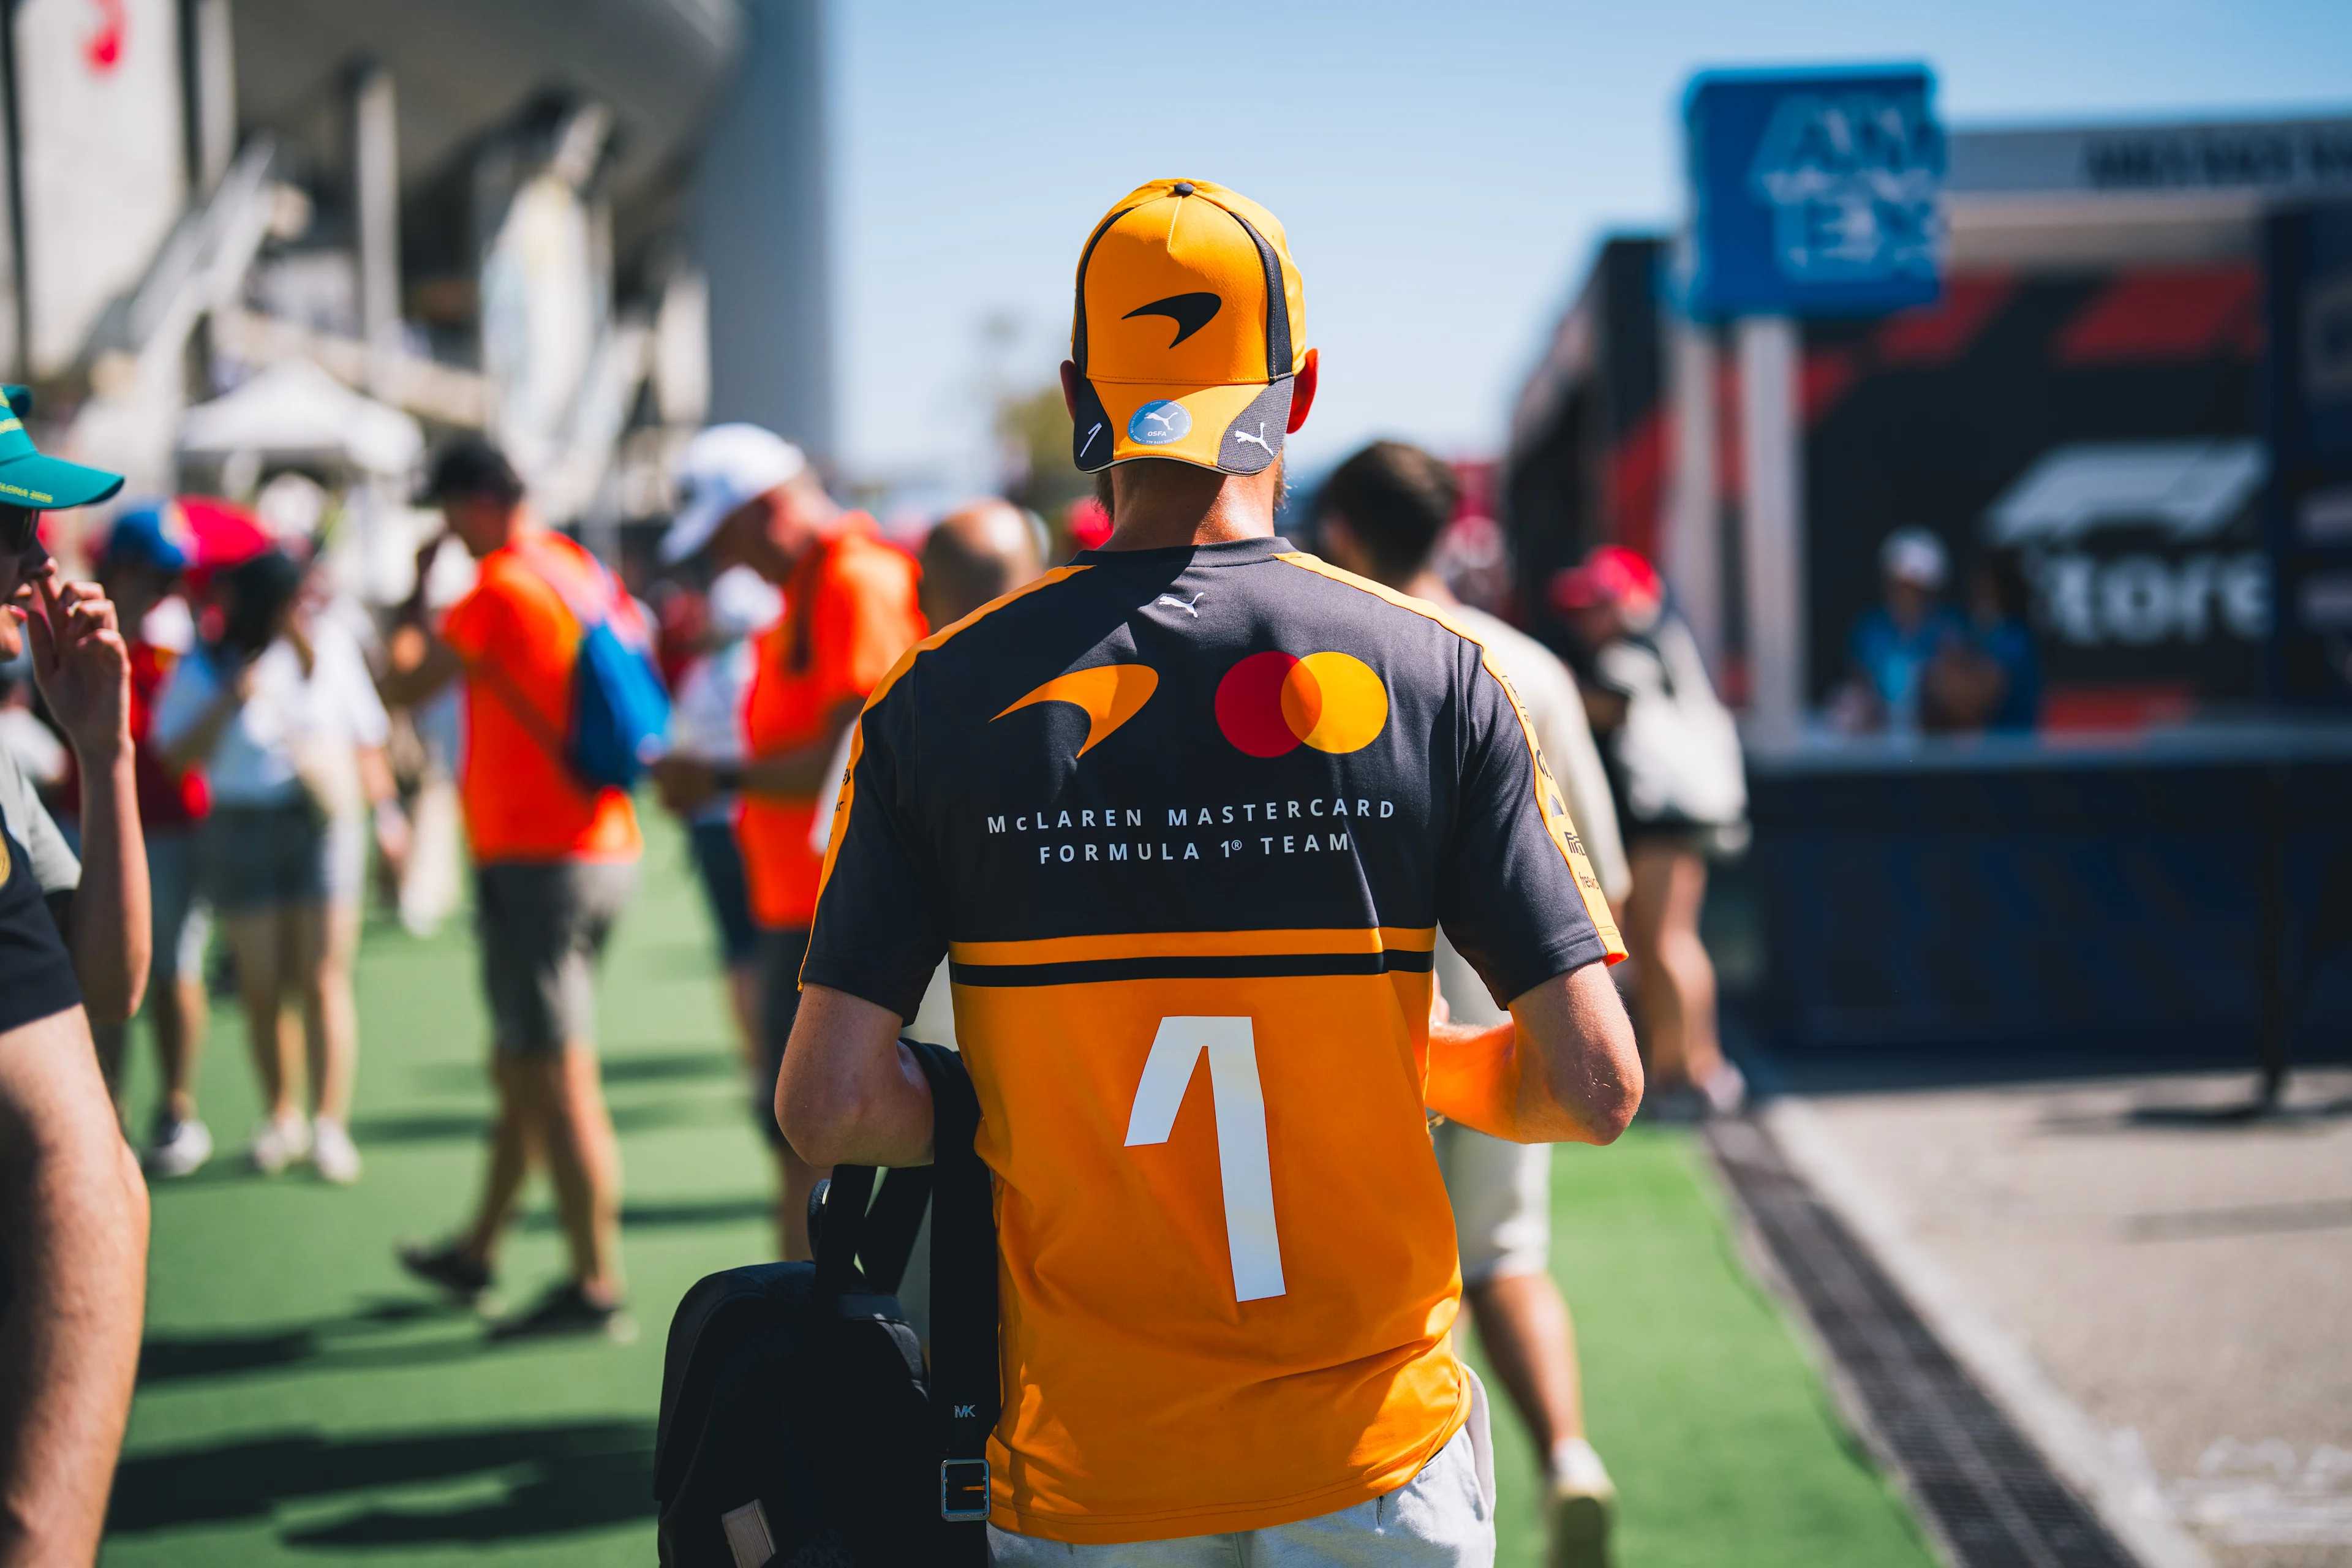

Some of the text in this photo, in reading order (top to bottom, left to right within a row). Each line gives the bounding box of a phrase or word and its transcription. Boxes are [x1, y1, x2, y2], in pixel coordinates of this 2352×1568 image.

[987, 798, 1393, 834] McLAREN MASTERCARD
[1040, 843, 1199, 864] FORMULA
[1260, 833, 1348, 854] TEAM
[1123, 1016, 1286, 1302] 1
[954, 1404, 976, 1419] MK
